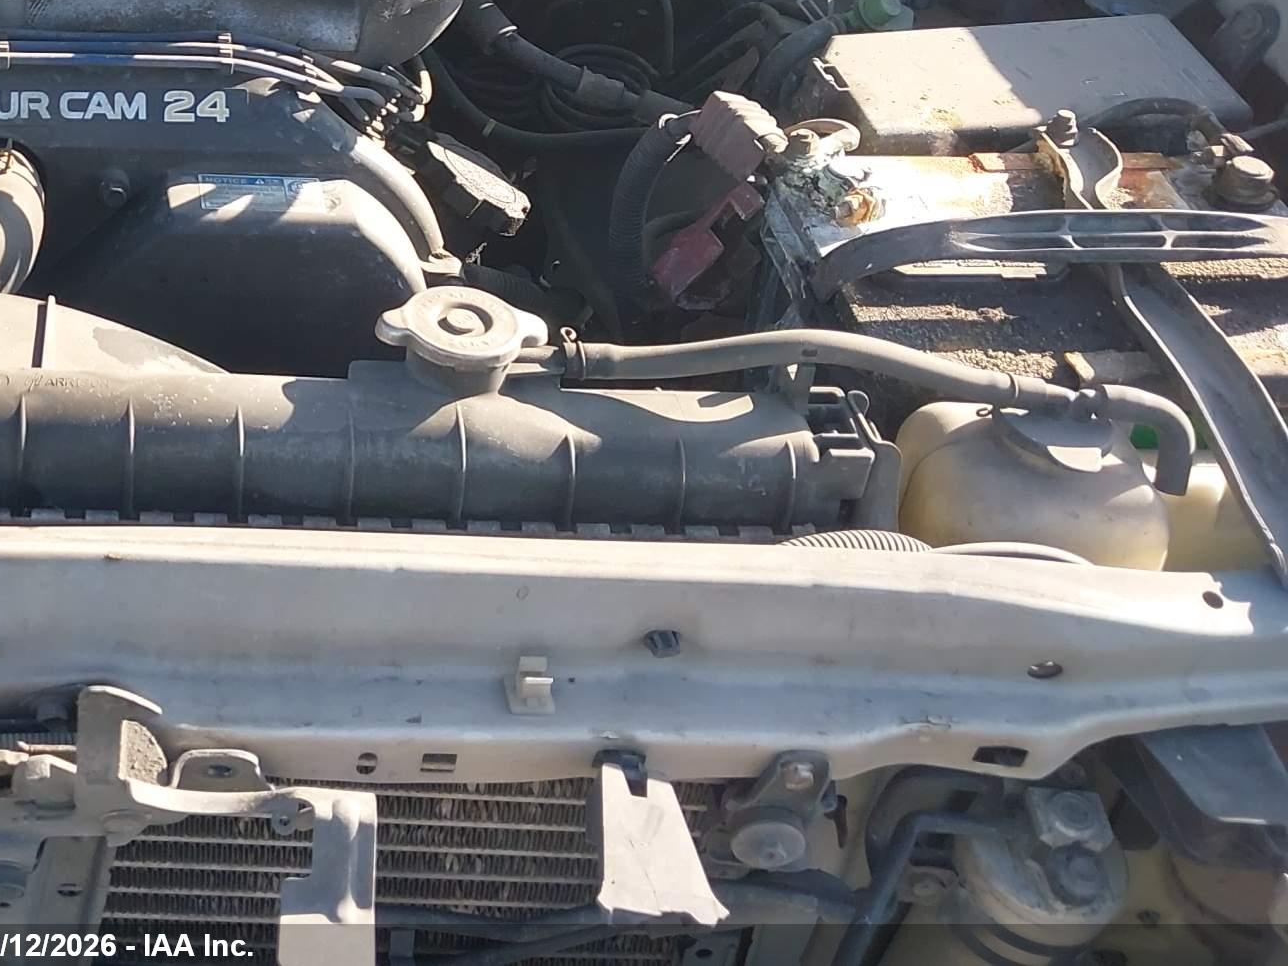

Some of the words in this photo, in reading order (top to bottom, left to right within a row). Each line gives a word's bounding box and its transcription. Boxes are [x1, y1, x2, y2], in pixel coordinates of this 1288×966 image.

[59, 91, 147, 120] CAM
[163, 90, 231, 122] 24
[204, 176, 248, 186] NOTICE
